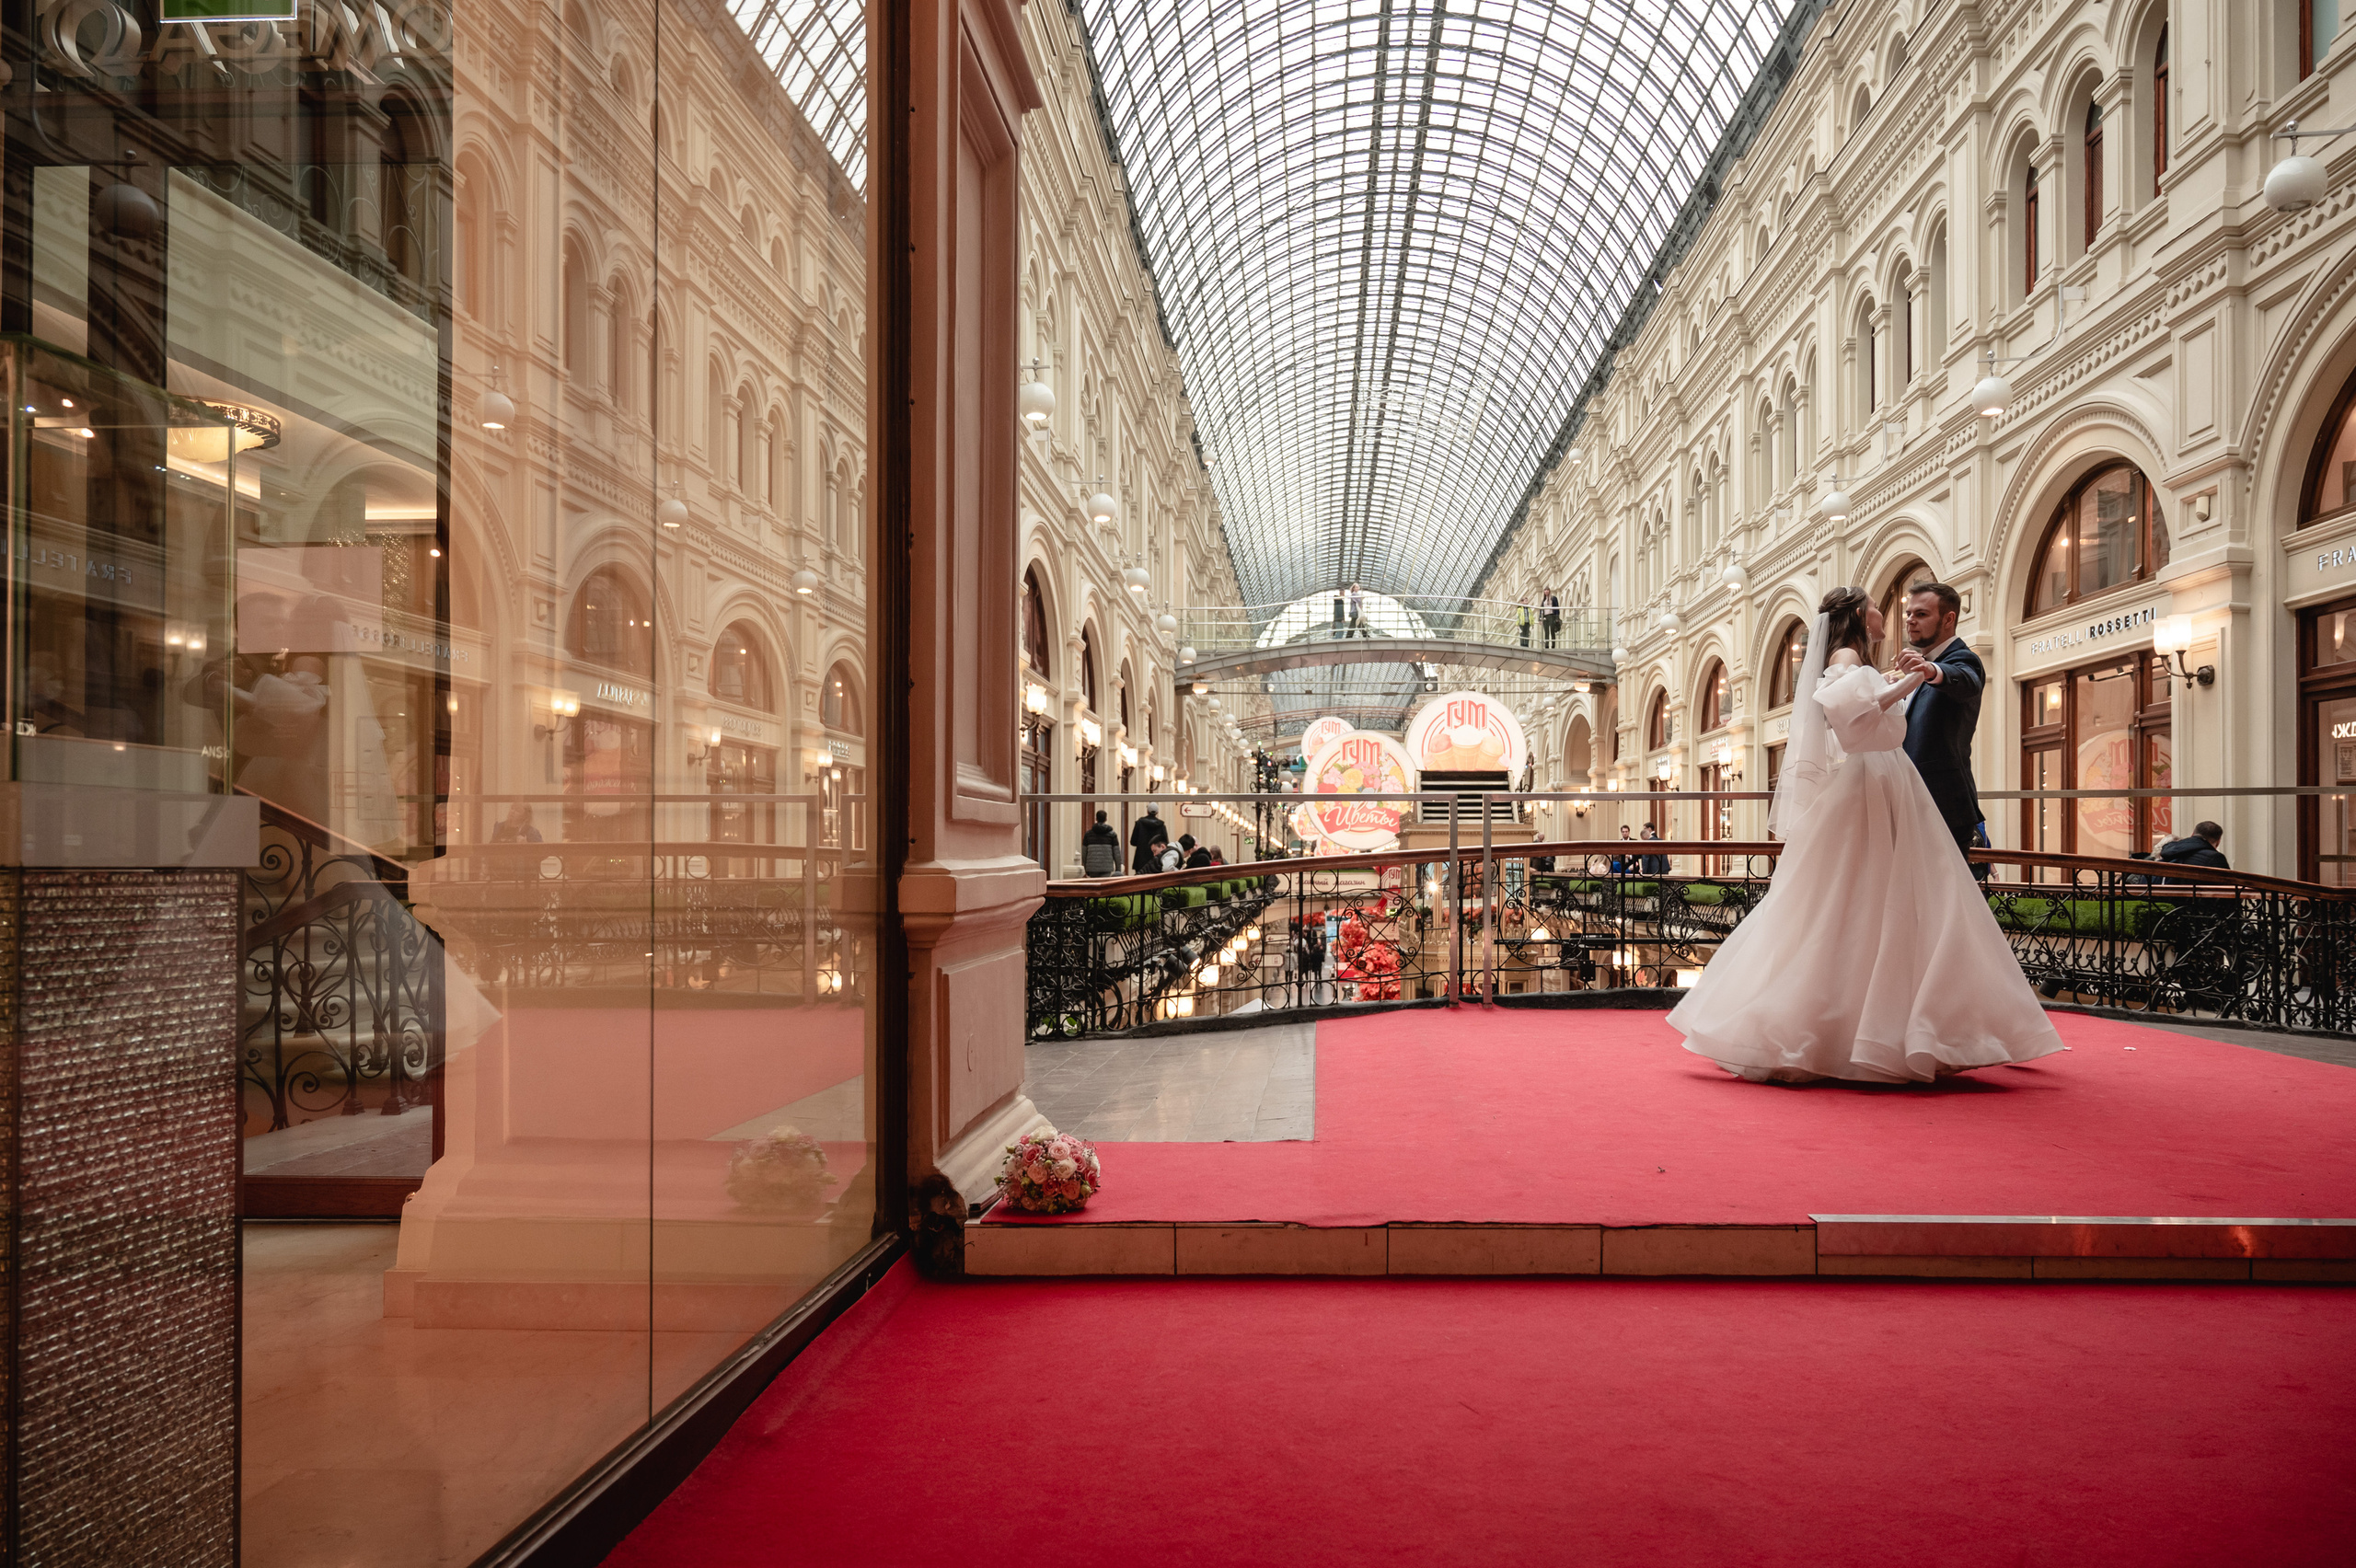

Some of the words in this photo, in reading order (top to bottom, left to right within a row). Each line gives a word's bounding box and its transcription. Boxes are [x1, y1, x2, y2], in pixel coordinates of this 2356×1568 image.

[2031, 628, 2089, 655] FRATELLI
[2090, 606, 2157, 640] ROSSETTI
[1323, 801, 1399, 832] Цветы
